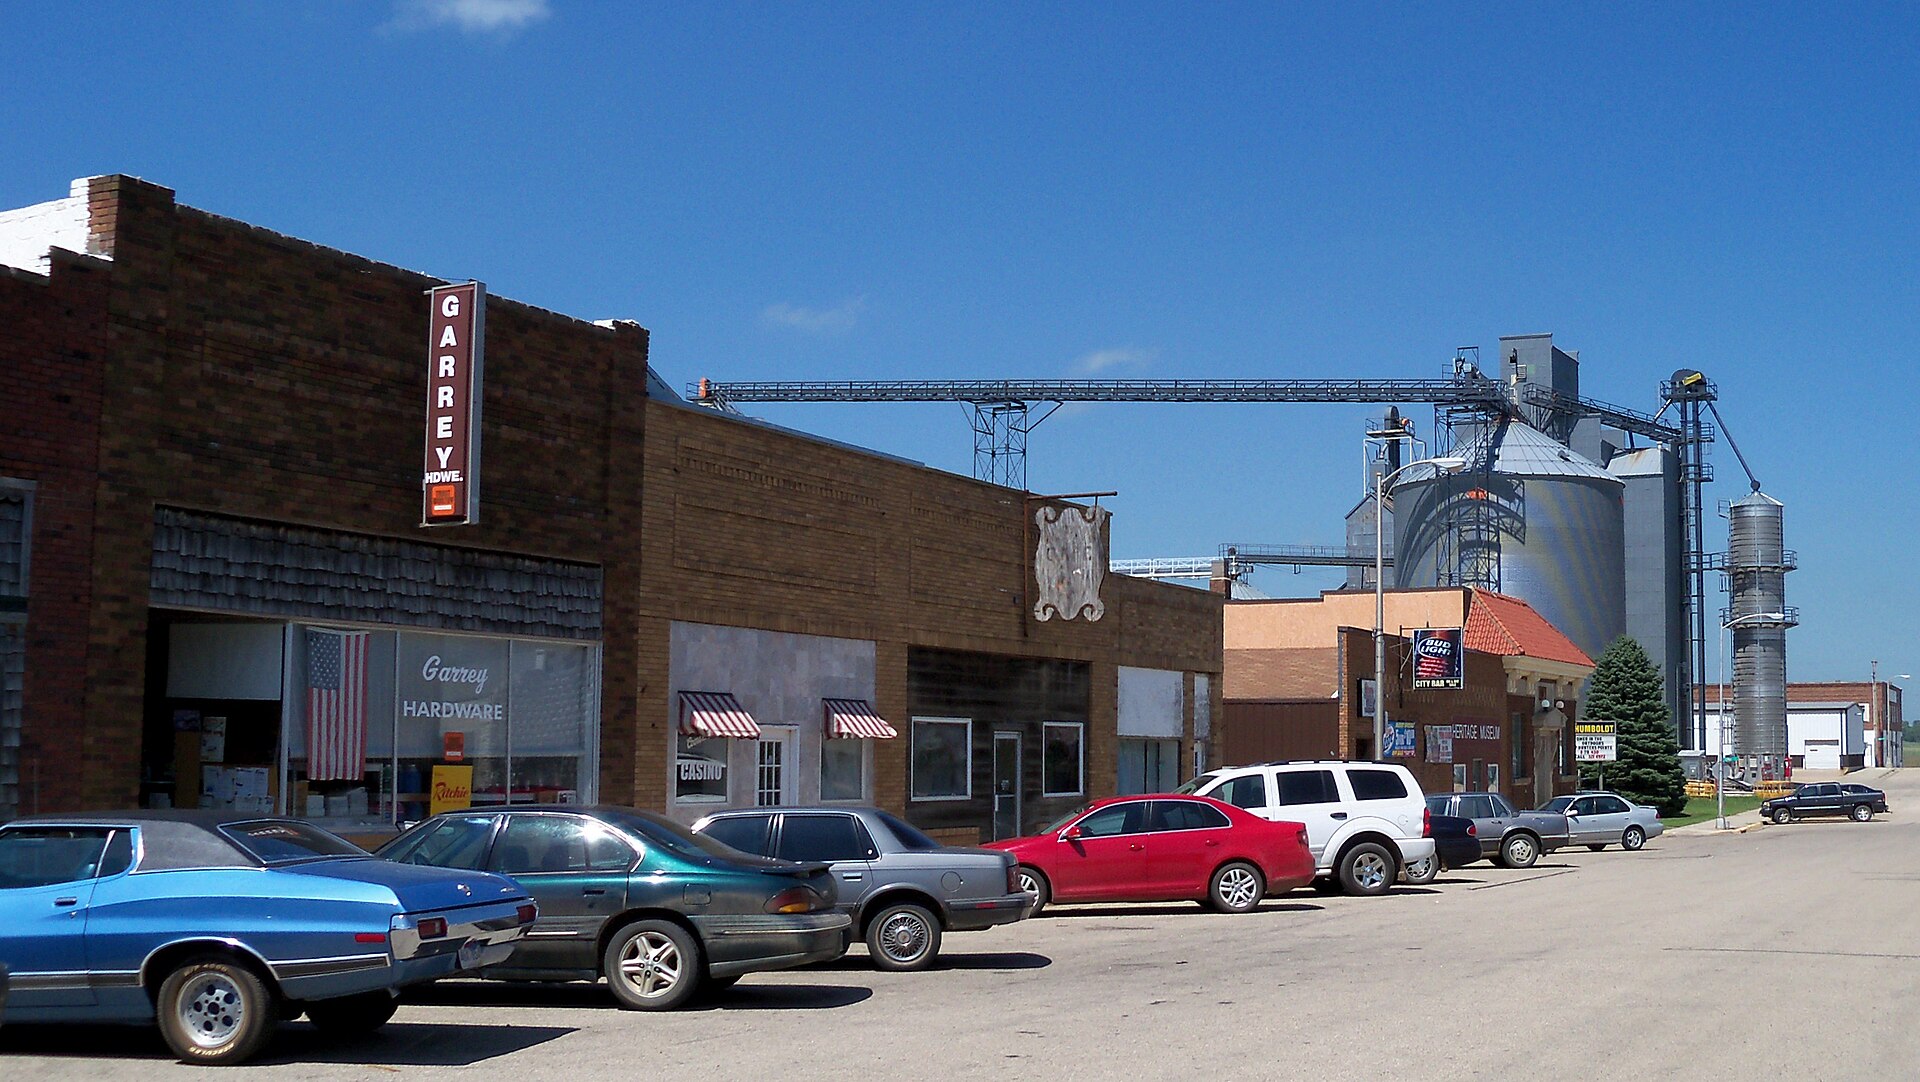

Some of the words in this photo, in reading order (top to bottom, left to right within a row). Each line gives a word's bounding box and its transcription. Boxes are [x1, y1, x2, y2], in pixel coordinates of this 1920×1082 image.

[435, 294, 460, 469] GARREY
[425, 470, 464, 484] HDWE.
[1420, 645, 1452, 656] LIGHT
[1425, 639, 1452, 649] BUD
[422, 655, 489, 694] Garrey
[1415, 679, 1431, 688] CITY
[1431, 679, 1445, 688] BAR
[403, 700, 503, 720] HARDWARE
[1451, 723, 1478, 739] HERITAGE
[1479, 725, 1500, 740] MUSEUM
[680, 763, 722, 781] CASINO
[433, 781, 468, 801] Ritchie
